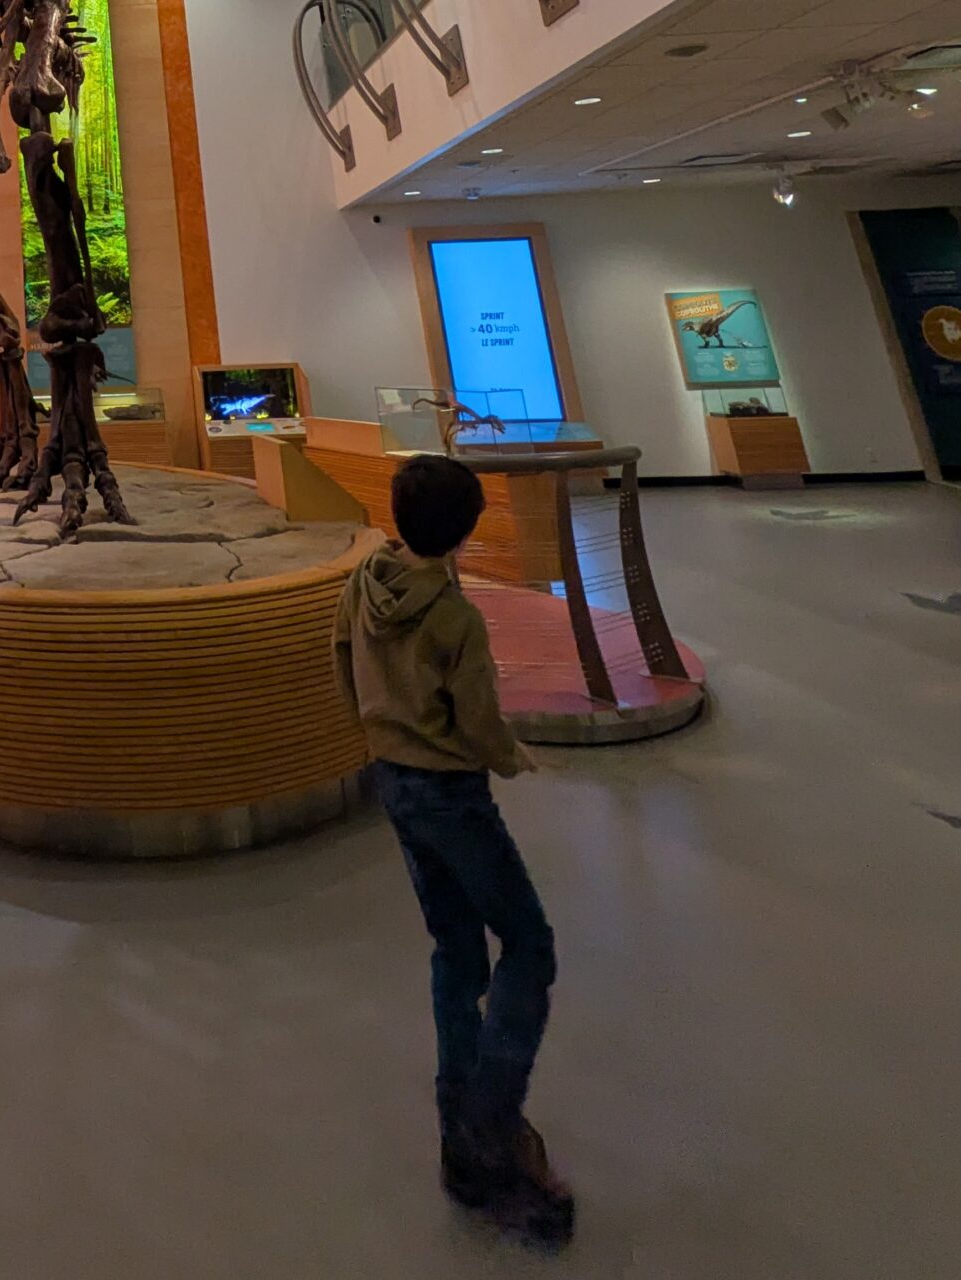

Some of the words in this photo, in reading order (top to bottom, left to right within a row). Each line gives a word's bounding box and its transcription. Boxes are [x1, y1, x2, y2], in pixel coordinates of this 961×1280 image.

[480, 312, 505, 321] SPRINT
[478, 324, 493, 334] 40
[495, 323, 520, 334] kmph
[481, 338, 489, 347] LE
[490, 337, 514, 347] SPRINT
